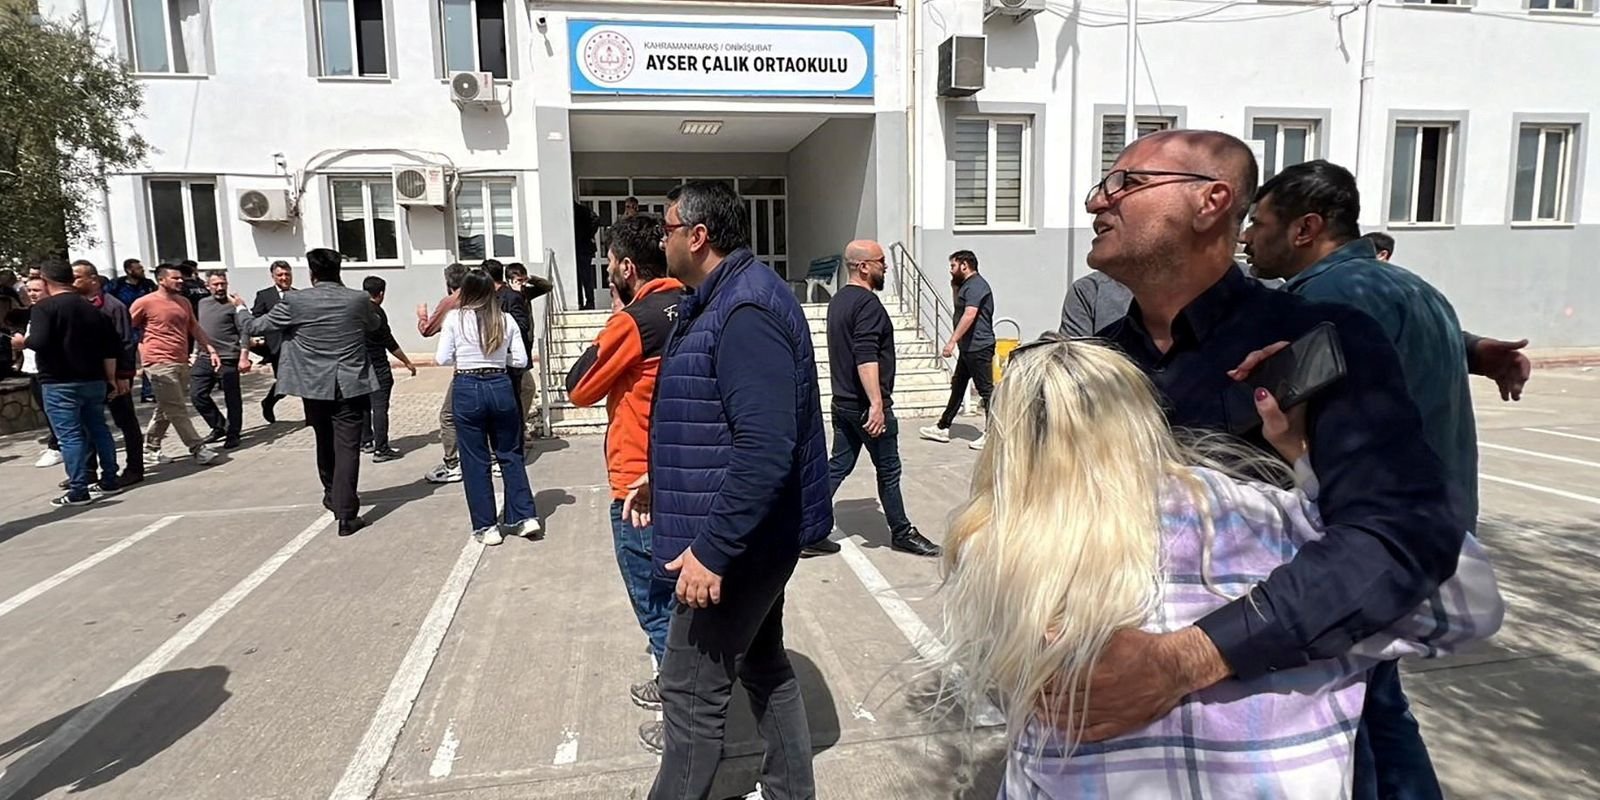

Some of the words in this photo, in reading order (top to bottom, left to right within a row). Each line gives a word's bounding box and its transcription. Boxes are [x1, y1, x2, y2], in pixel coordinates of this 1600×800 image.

[646, 54, 698, 71] AYSER
[702, 55, 749, 74] ÇALIK
[753, 56, 848, 73] ORTAOKULU
